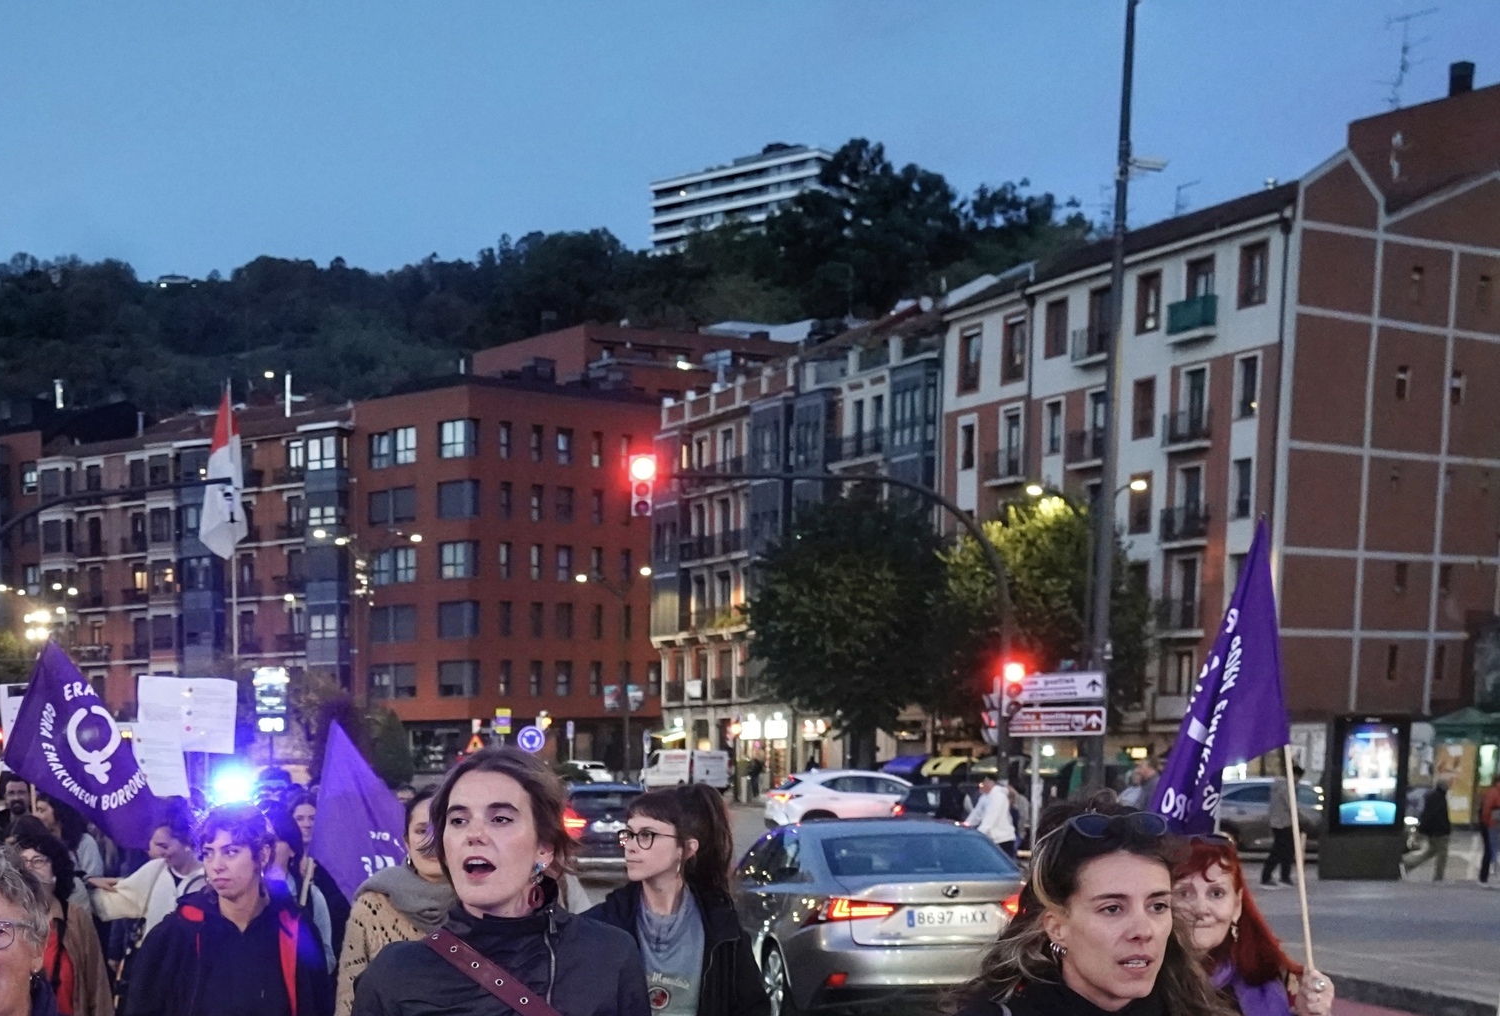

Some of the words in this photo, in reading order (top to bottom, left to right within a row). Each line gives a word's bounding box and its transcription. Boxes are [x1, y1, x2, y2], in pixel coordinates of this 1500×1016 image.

[39, 702, 57, 739] GORA
[917, 911, 954, 925] 8697
[960, 910, 988, 924] HXX
